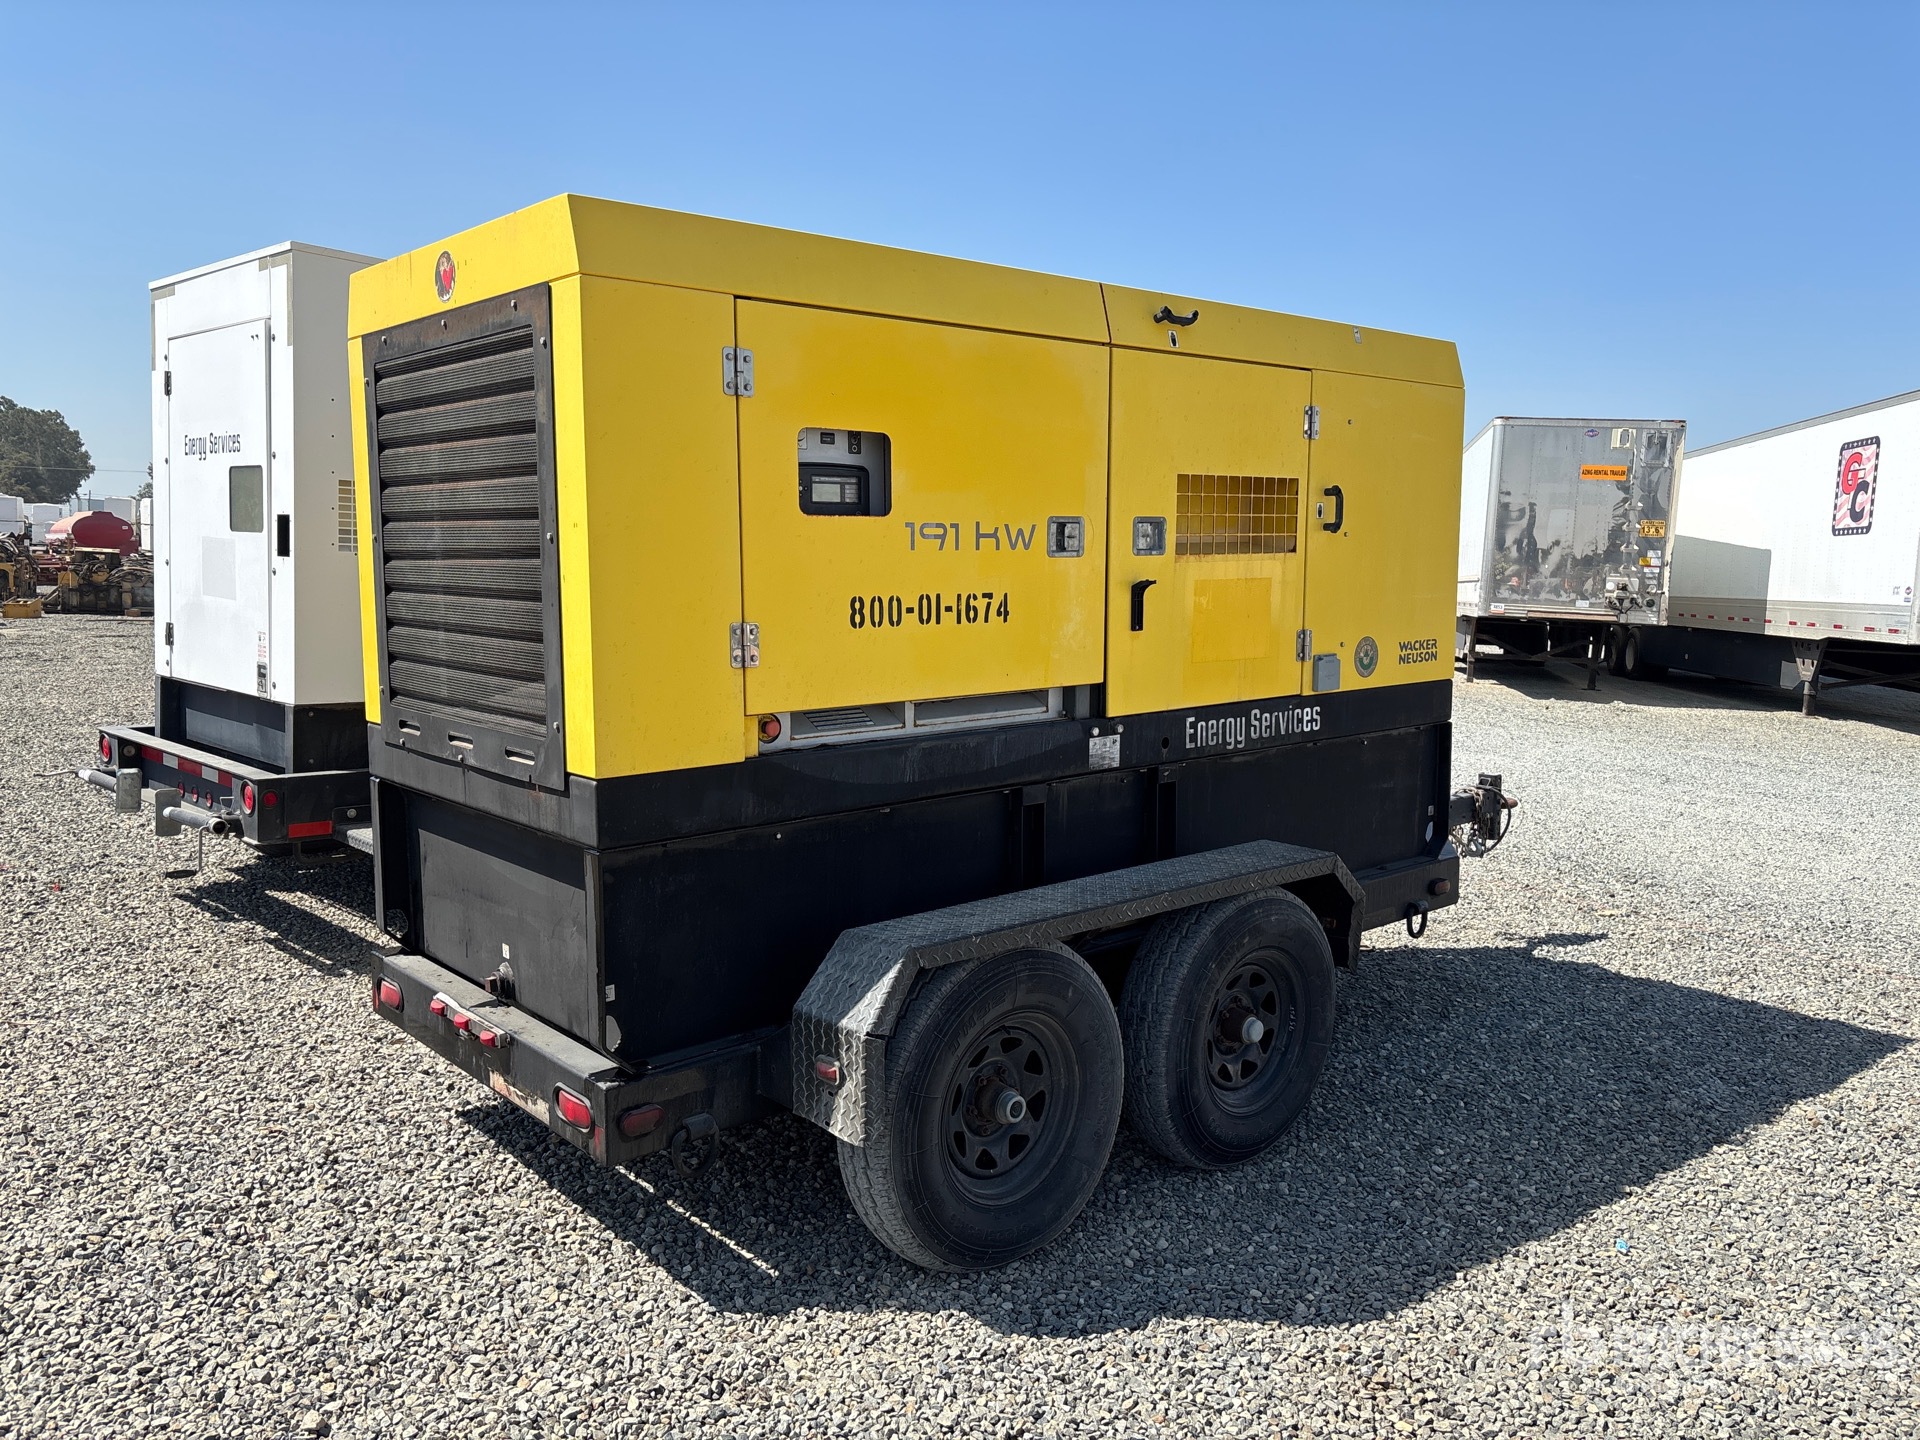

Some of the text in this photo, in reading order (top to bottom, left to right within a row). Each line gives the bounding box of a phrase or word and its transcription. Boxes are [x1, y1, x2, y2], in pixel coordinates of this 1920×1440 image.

[184, 430, 241, 461] Energy Services
[904, 522, 960, 551] 191
[849, 591, 1010, 630] 800-01-1674
[1398, 638, 1438, 653] WACKER
[1398, 650, 1438, 666] NEUSON
[1185, 704, 1321, 750] Energy Services
